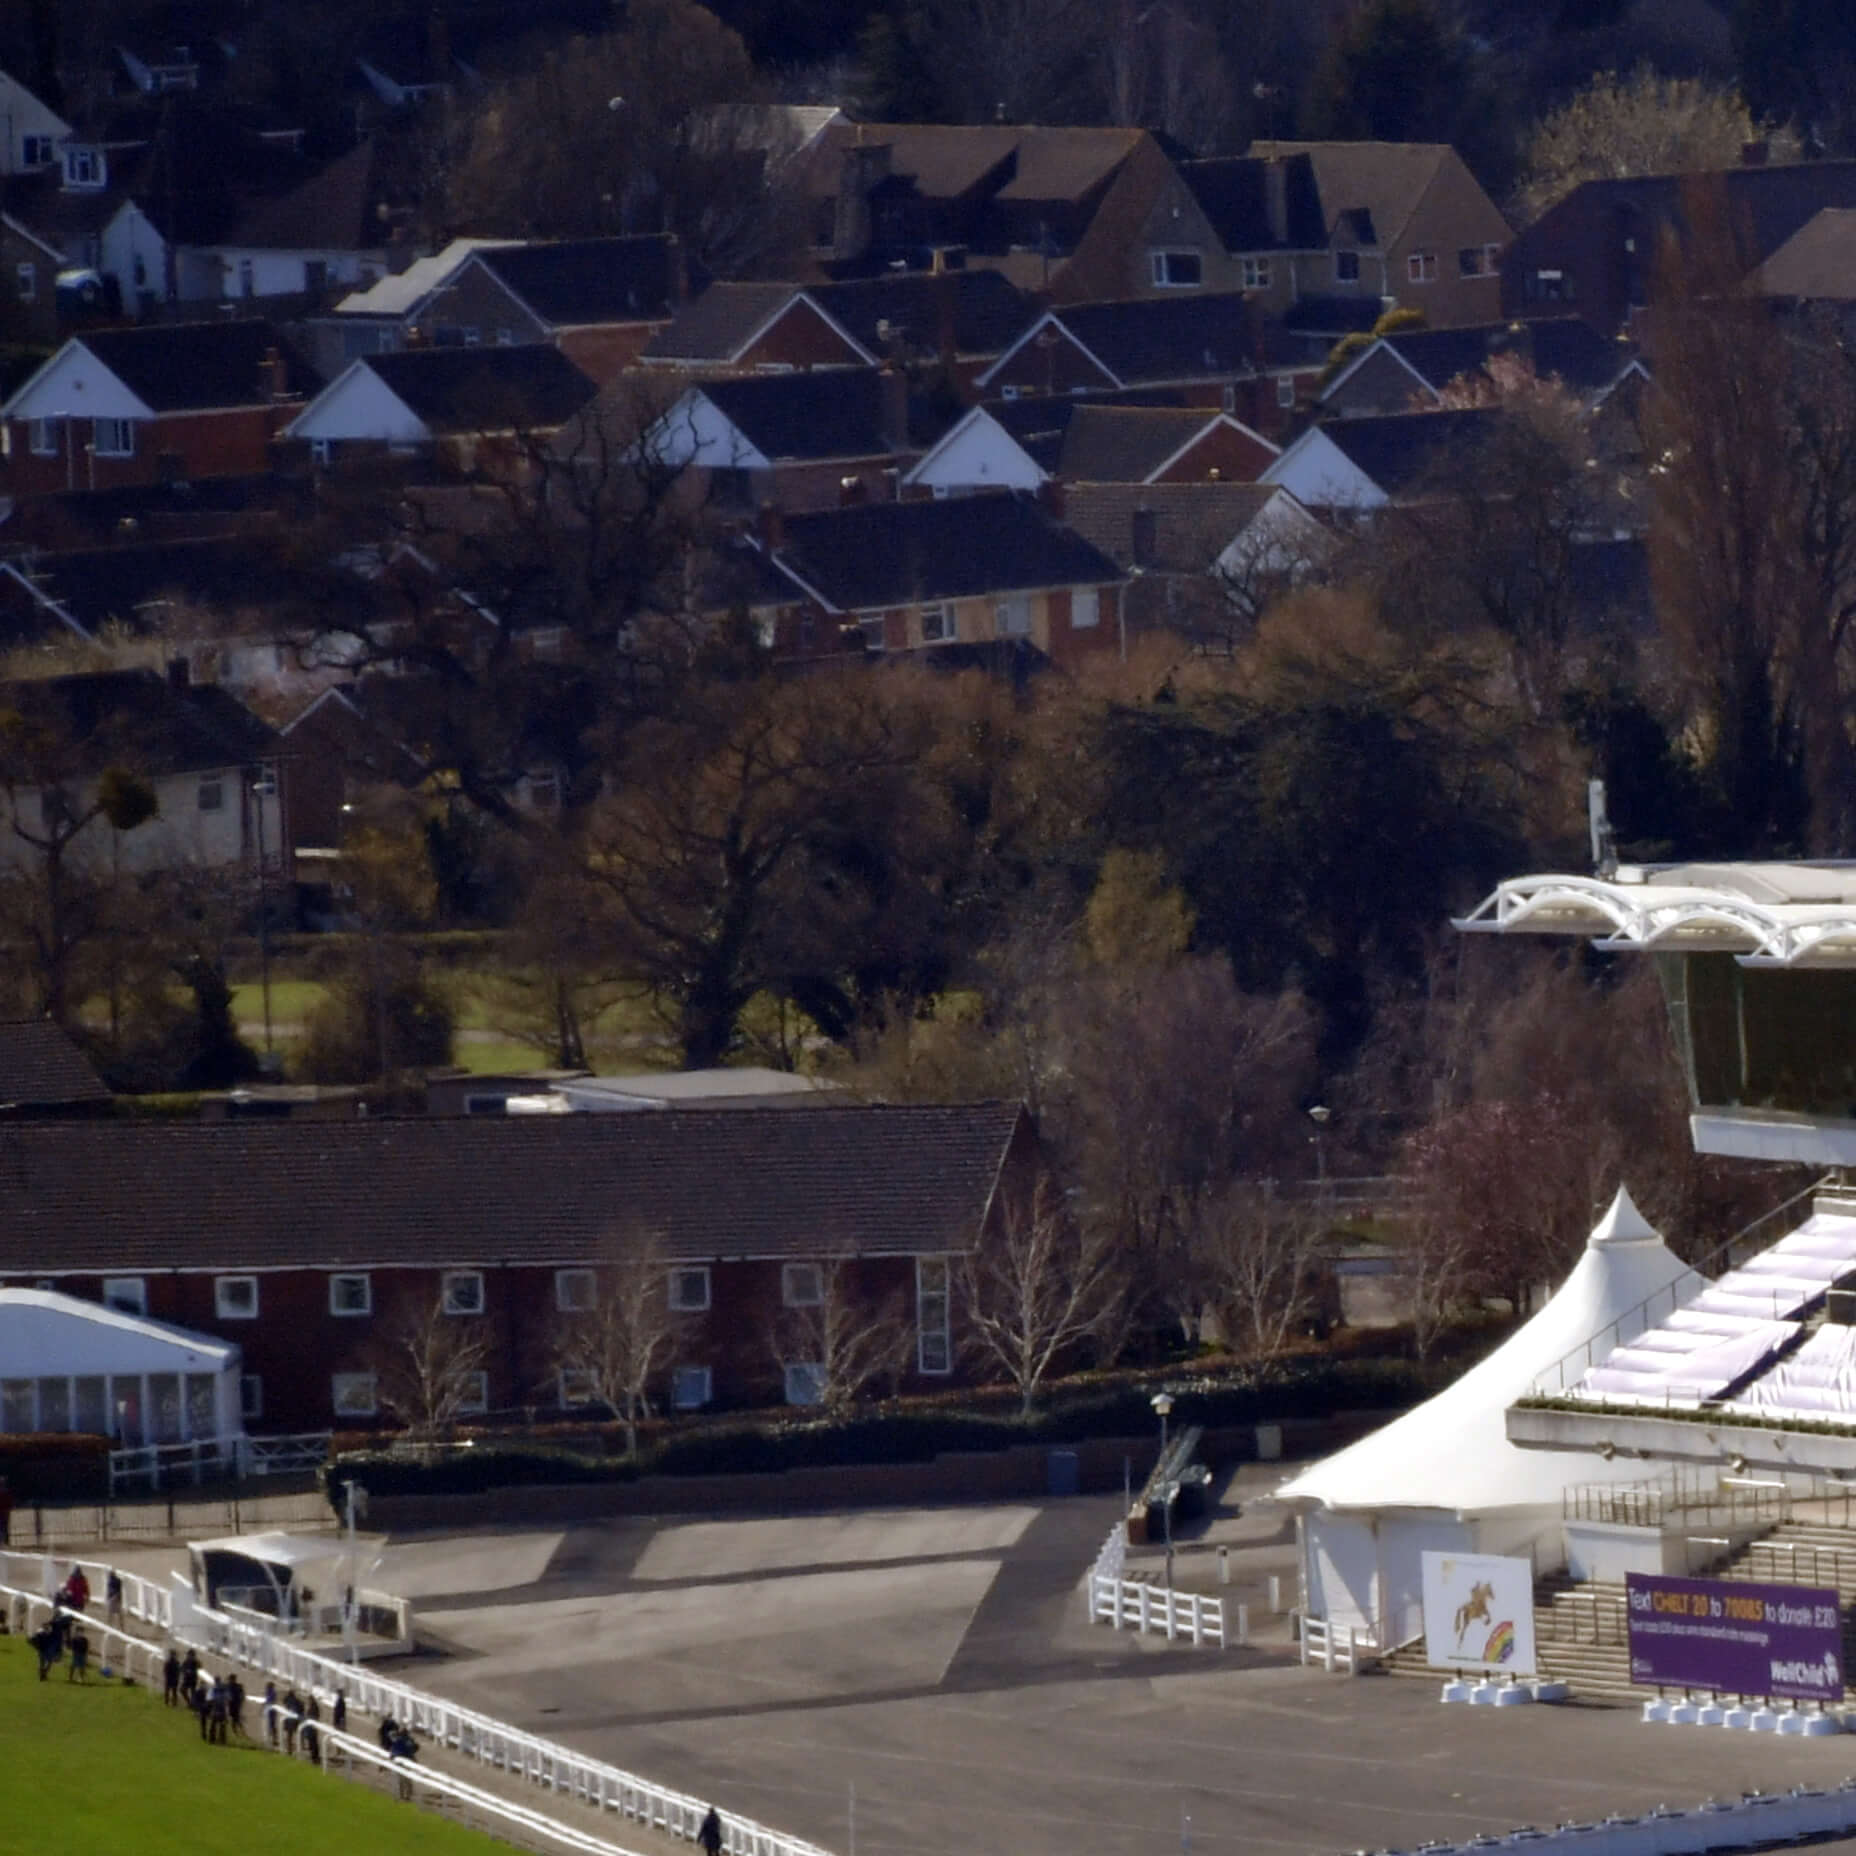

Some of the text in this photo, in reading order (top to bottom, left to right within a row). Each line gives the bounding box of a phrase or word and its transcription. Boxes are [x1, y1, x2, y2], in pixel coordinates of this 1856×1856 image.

[1628, 1587, 1651, 1611] Text
[1710, 1597, 1721, 1617] to
[1765, 1602, 1776, 1622] to
[1771, 1660, 1825, 1687] WellChild
